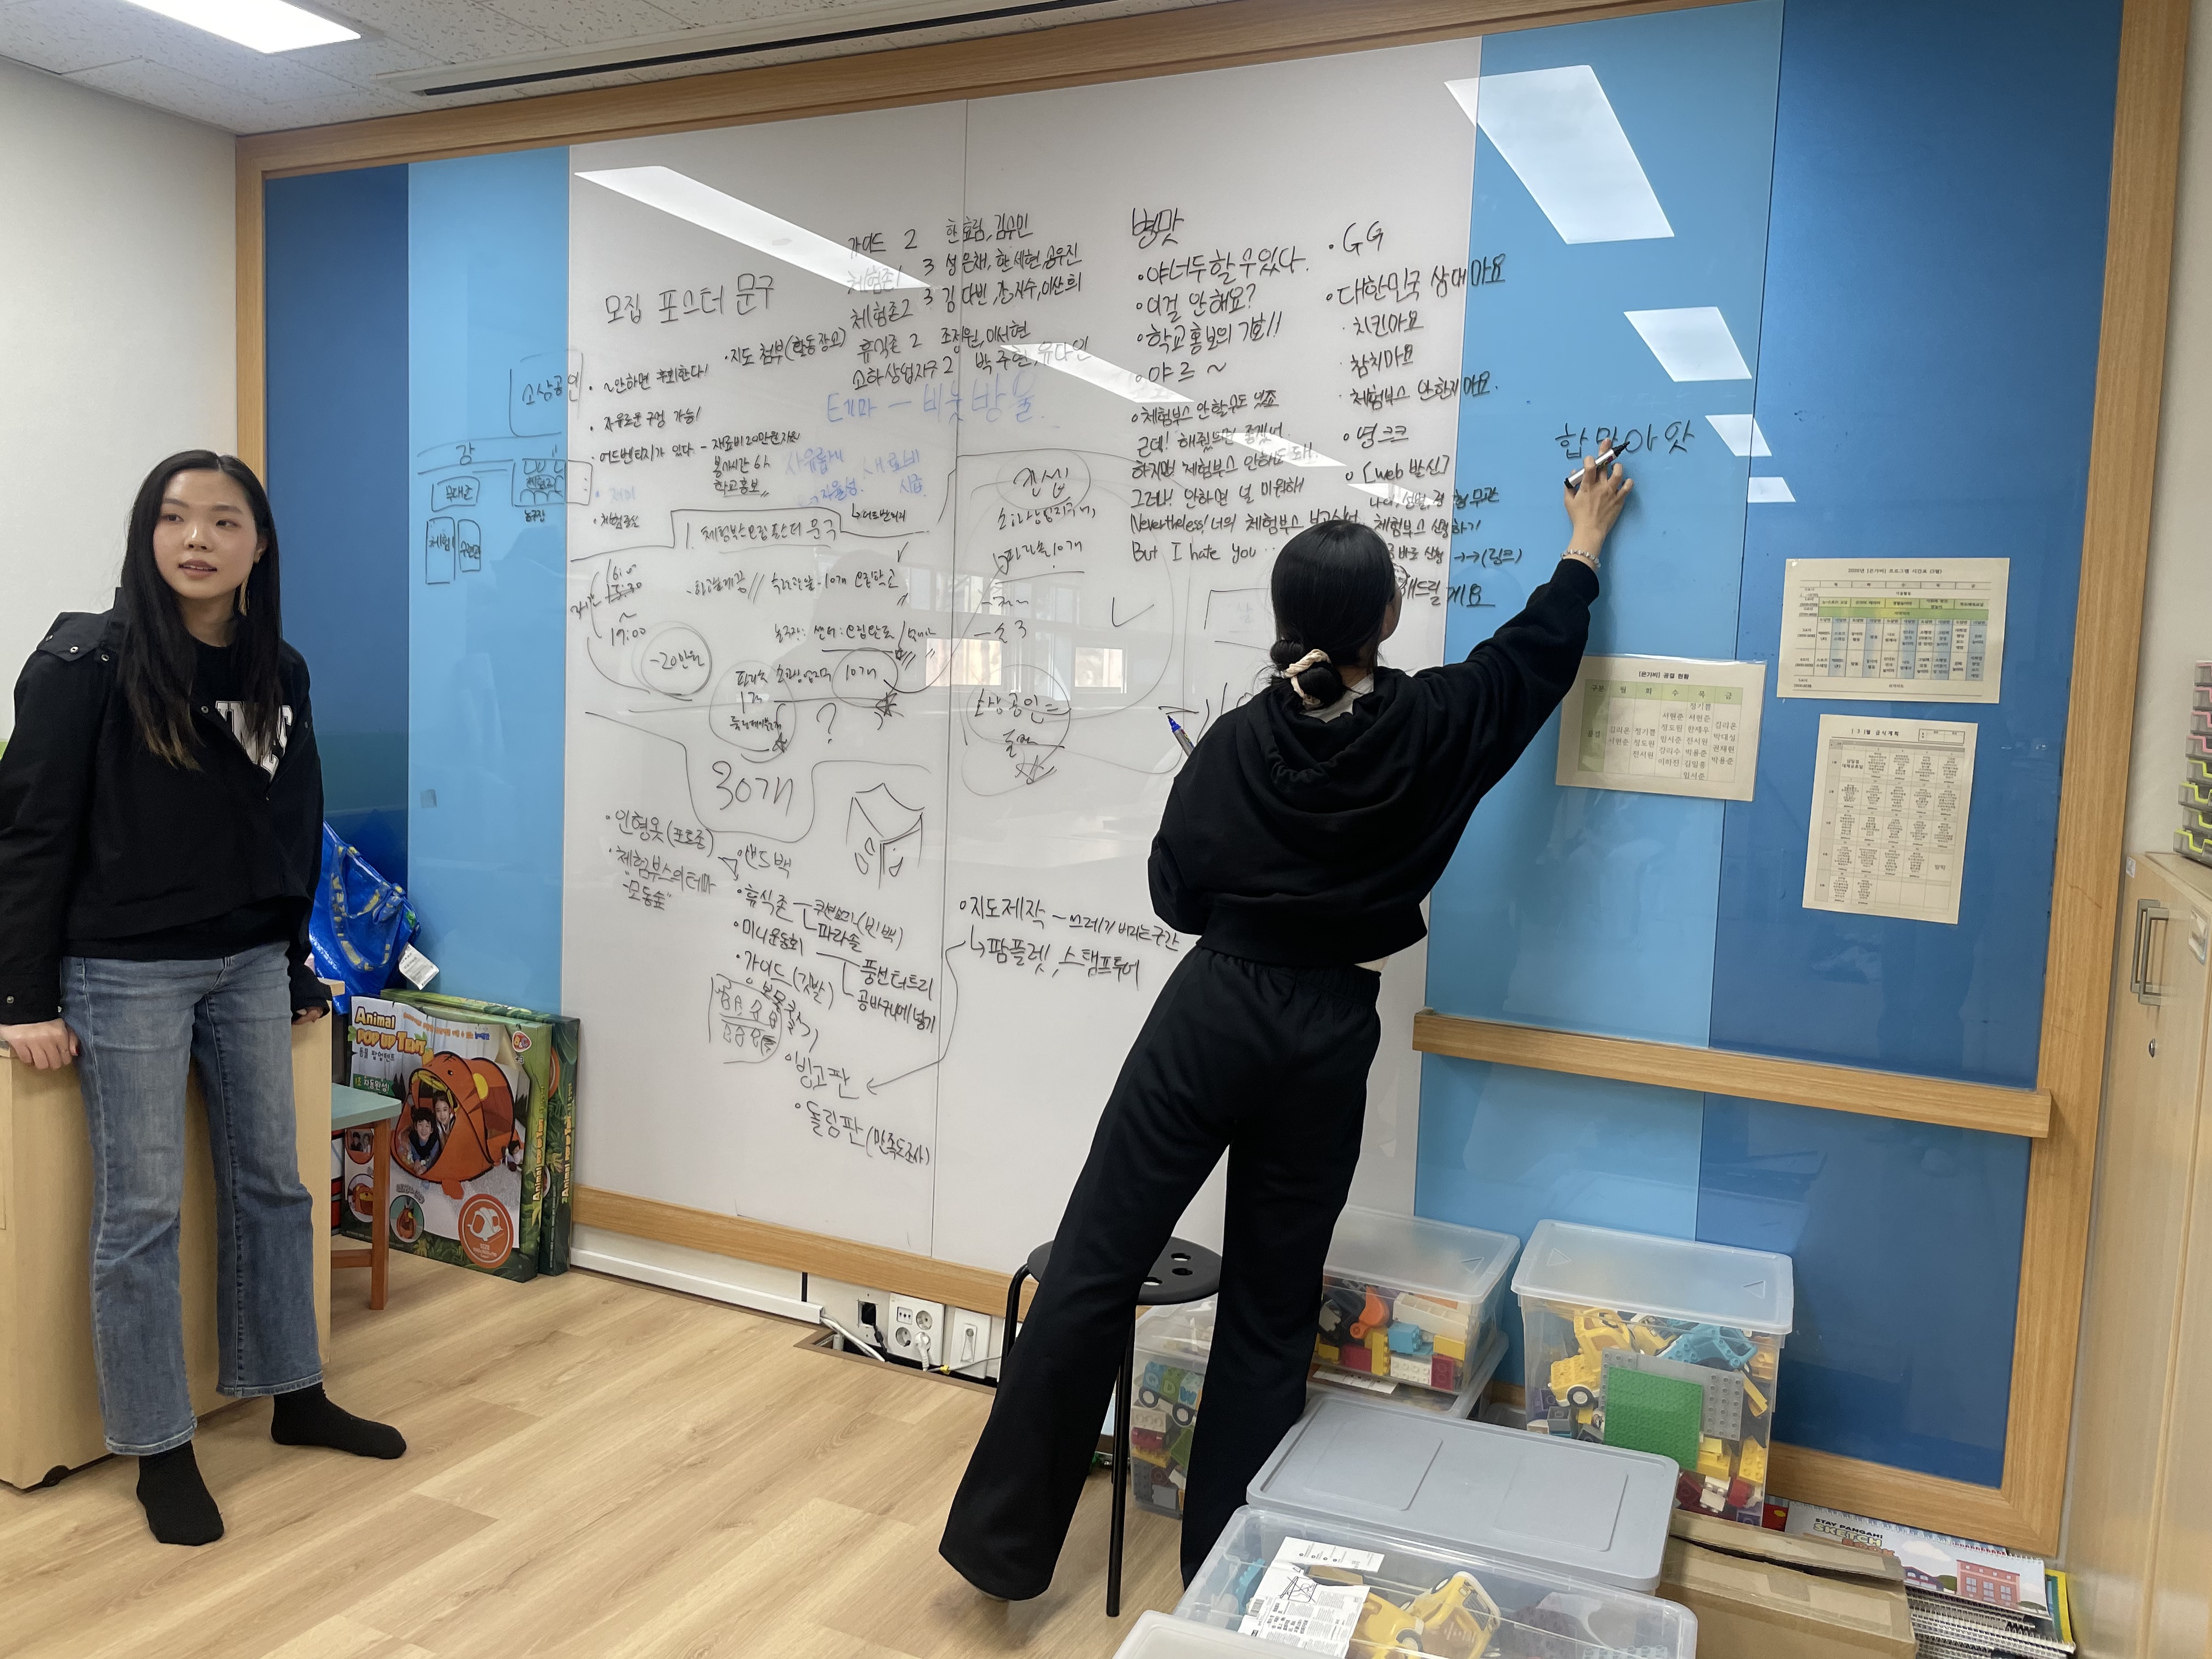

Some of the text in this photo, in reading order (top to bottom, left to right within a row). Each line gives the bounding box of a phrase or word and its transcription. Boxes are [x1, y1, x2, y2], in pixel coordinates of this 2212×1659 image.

[849, 233, 886, 259] 가이드
[904, 229, 917, 250] 2
[1344, 221, 1384, 256] GG
[923, 258, 934, 275] 3
[924, 287, 934, 306] 3
[1337, 268, 1420, 304] 대한민국
[606, 273, 774, 324] 모집 포스터 문구
[1148, 294, 1178, 323] 이걸
[1353, 310, 1424, 337] 치킨마요
[910, 333, 922, 348] 2
[730, 348, 754, 366] 지도
[943, 357, 953, 374] 2
[1350, 344, 1414, 377] 참치마요
[1350, 384, 1410, 410] 체험부스
[604, 412, 641, 432] 자유로운
[1142, 406, 1193, 427] 체험부스
[456, 442, 475, 465] 강
[1131, 513, 1209, 535] Nevertheless!
[1245, 513, 1304, 535] 체험부스
[1374, 514, 1426, 538] 체험부스
[1132, 540, 1257, 565] But I hate you
[818, 922, 862, 953] 파라솔
[357, 1028, 380, 1047] POP
[380, 1032, 397, 1050] UP
[1815, 1518, 1837, 1527] STAY
[1813, 1522, 1882, 1547] SKETCH
[1842, 1538, 1895, 1556] BOOK
